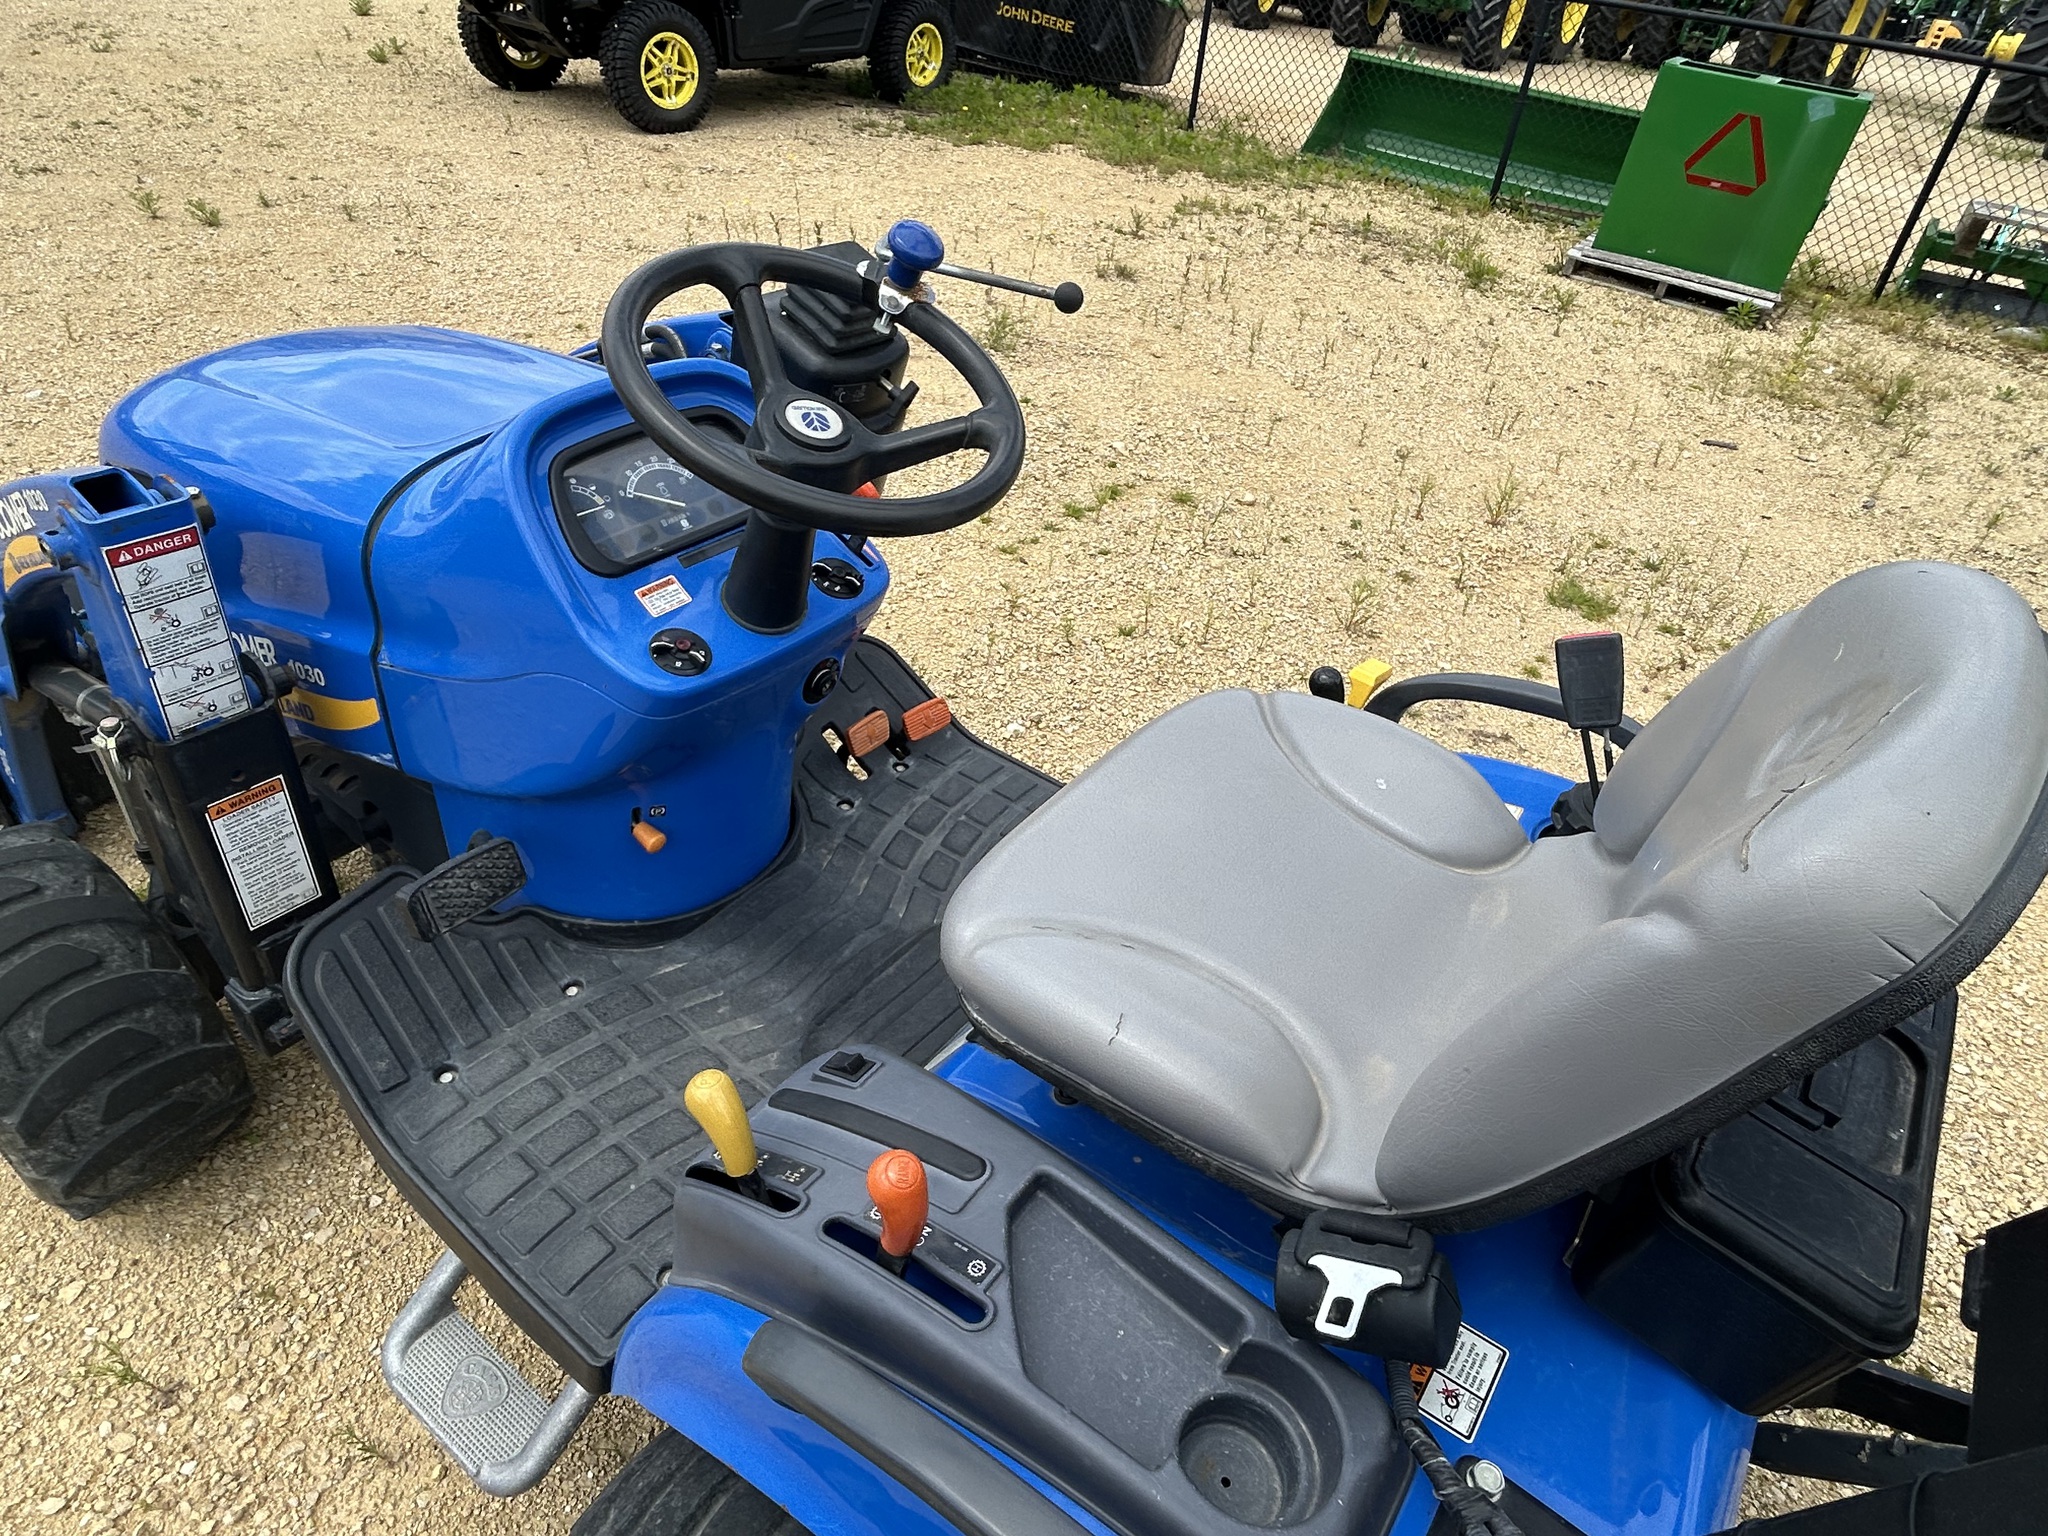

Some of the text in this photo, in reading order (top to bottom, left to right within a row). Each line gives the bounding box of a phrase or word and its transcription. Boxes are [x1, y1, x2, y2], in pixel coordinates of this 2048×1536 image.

[996, 2, 1076, 33] JOHN DEERE
[134, 533, 192, 557] DANGER
[228, 784, 276, 809] WARNING
